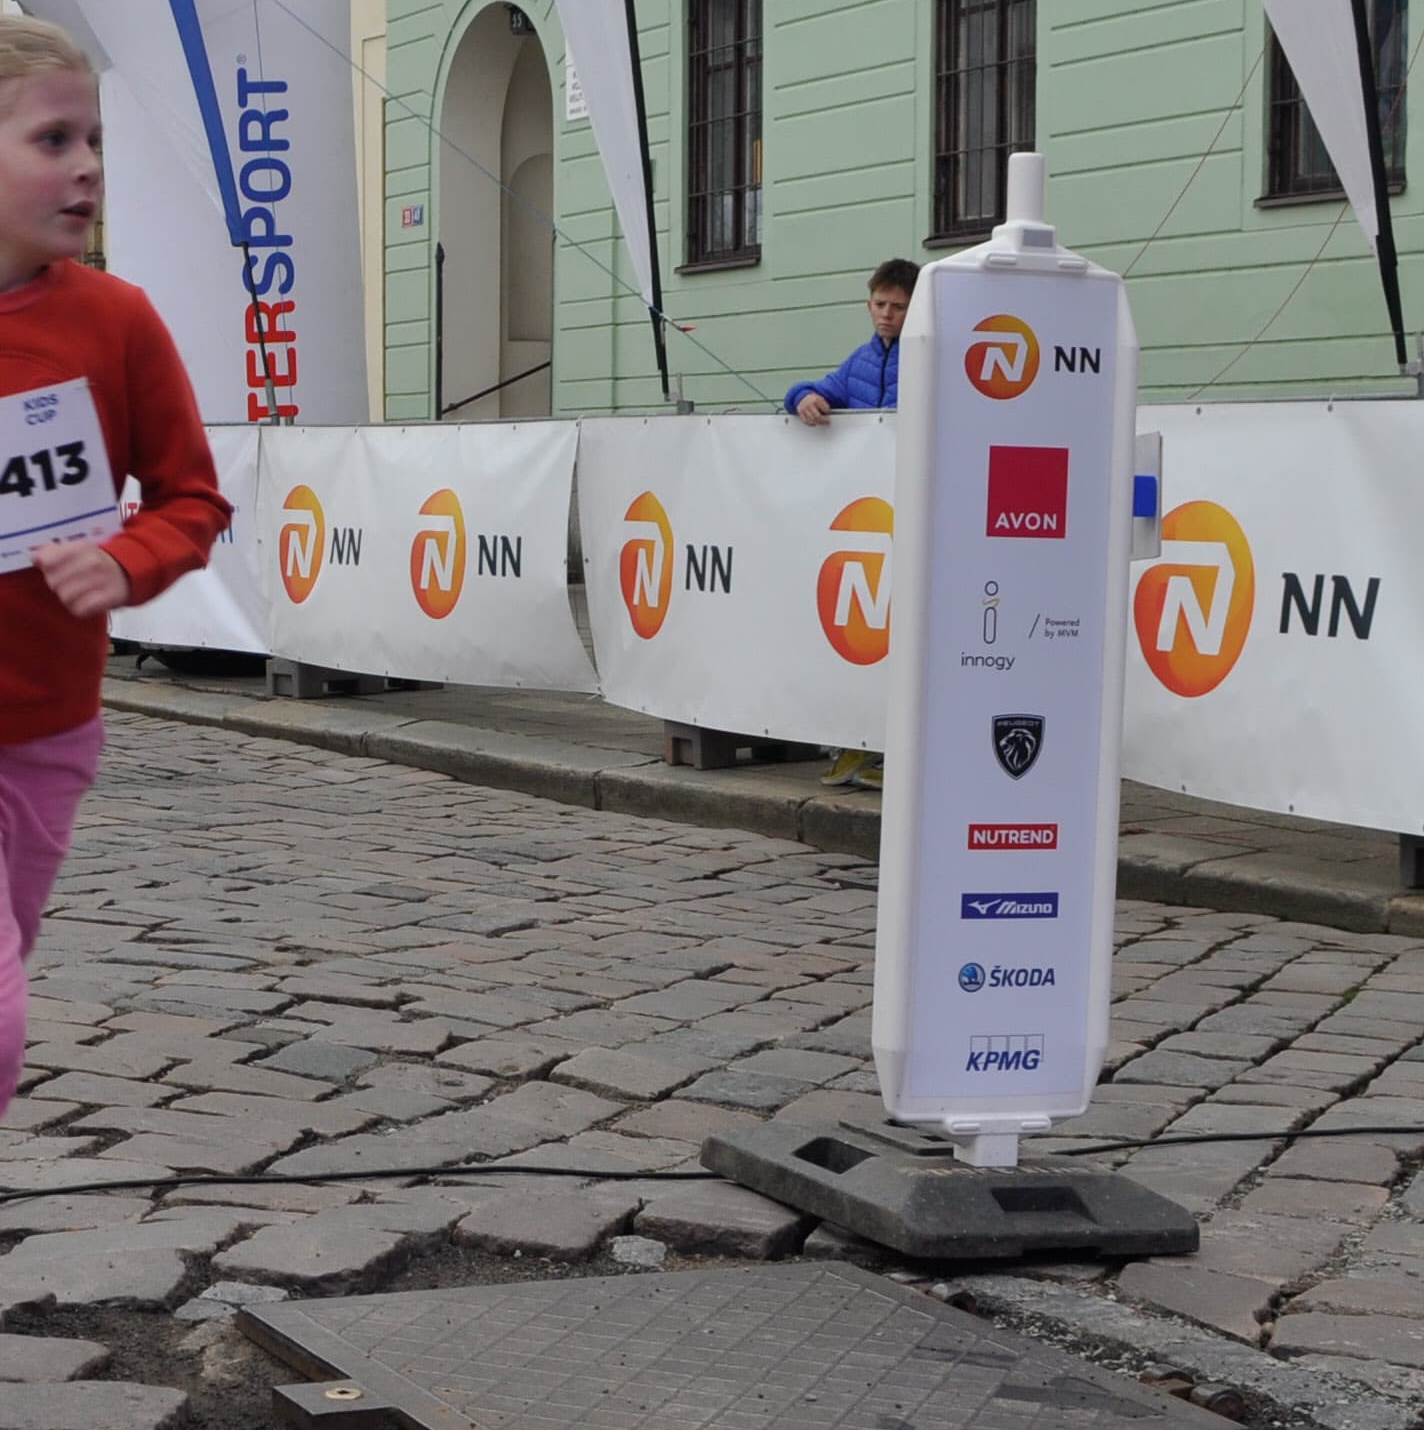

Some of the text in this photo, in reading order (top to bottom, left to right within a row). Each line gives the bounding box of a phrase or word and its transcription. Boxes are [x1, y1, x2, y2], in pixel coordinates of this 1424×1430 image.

[237, 67, 298, 424] TERSPORT
[1053, 345, 1101, 374] NN
[24, 393, 58, 411] KIDS
[26, 409, 57, 425] CUP
[994, 513, 1057, 531] AVON
[329, 527, 363, 566] NN
[478, 534, 522, 578] NN
[685, 544, 733, 594] NN
[1279, 572, 1380, 640] NN
[961, 652, 1016, 670] innogy
[973, 829, 1054, 845] NUTREND
[989, 965, 1056, 987] ŠKODA
[966, 1049, 1041, 1072] KPMG
